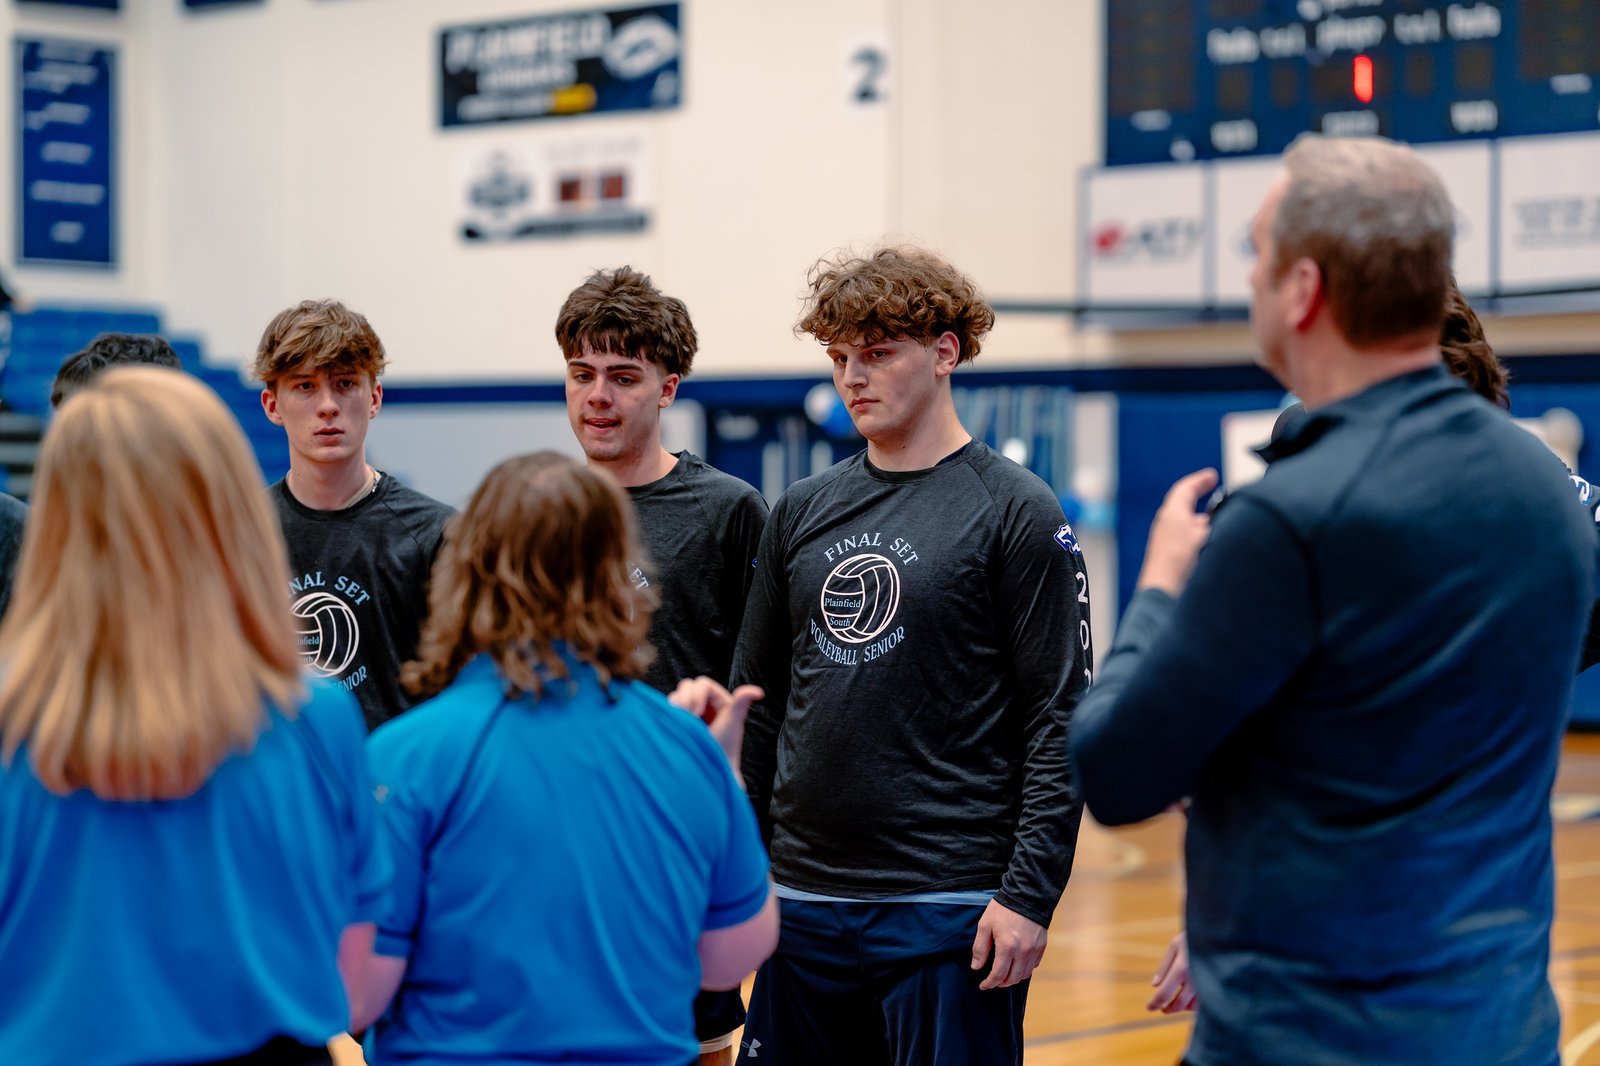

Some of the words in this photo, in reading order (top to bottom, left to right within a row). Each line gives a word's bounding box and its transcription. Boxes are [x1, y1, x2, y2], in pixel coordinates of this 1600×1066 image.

[852, 46, 888, 103] 2
[824, 532, 882, 563] FINAL
[889, 537, 919, 566] SET
[288, 571, 326, 598] NAL
[334, 575, 371, 605] SET
[629, 567, 650, 591] ET
[824, 597, 861, 608] Plainfield
[829, 617, 851, 627] South
[811, 618, 858, 665] VOLLEYBALL
[863, 626, 905, 662] SENIOR
